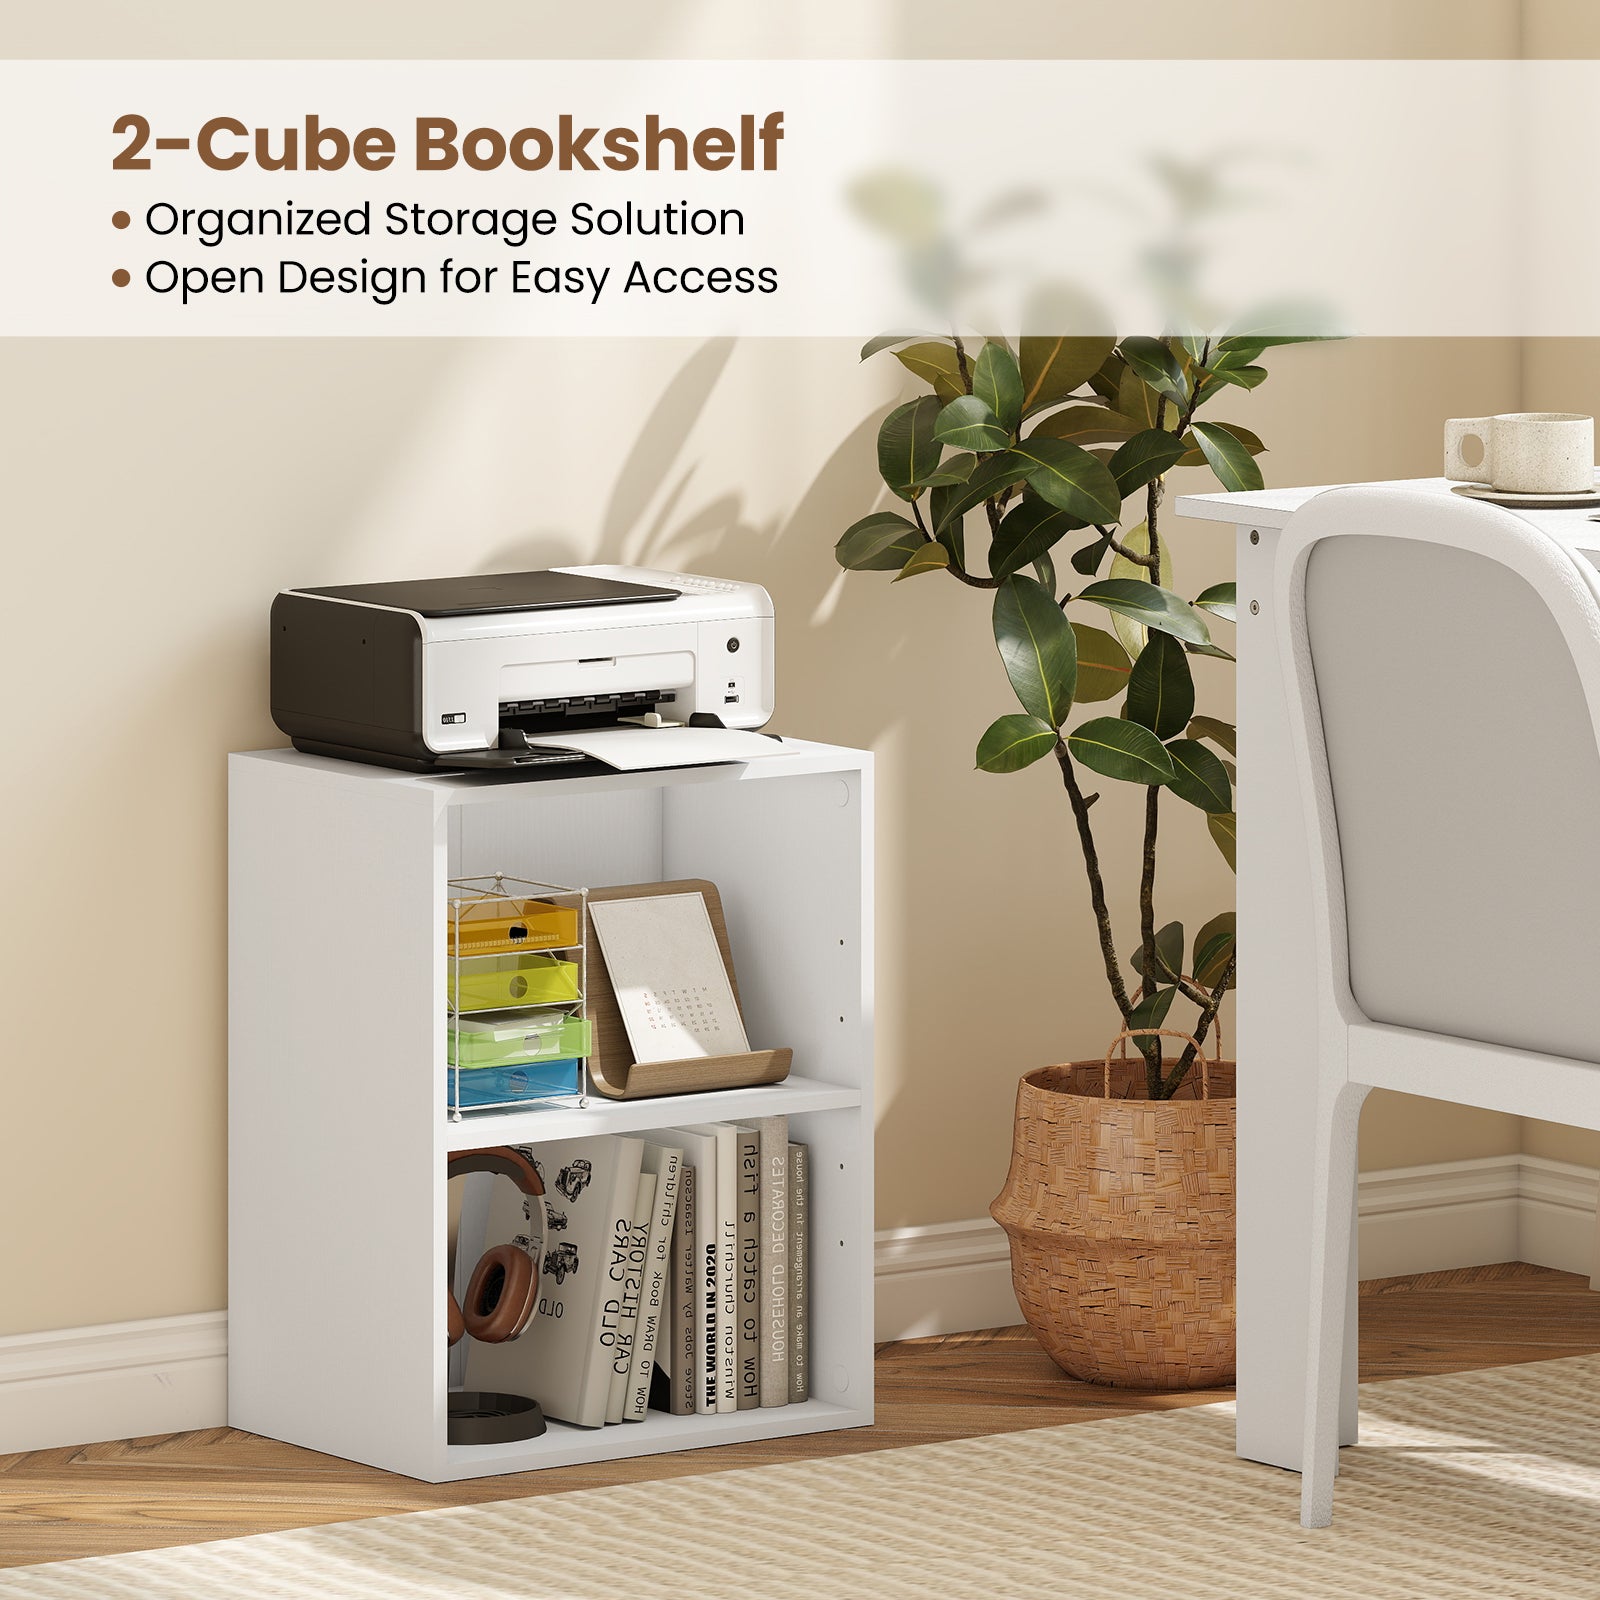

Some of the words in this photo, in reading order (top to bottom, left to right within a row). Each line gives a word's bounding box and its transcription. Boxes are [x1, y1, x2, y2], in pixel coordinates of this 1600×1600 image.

[705, 1243, 716, 1288] 2020
[705, 1292, 716, 1309] IN
[705, 1312, 716, 1373] WORLD
[705, 1376, 716, 1407] THE
